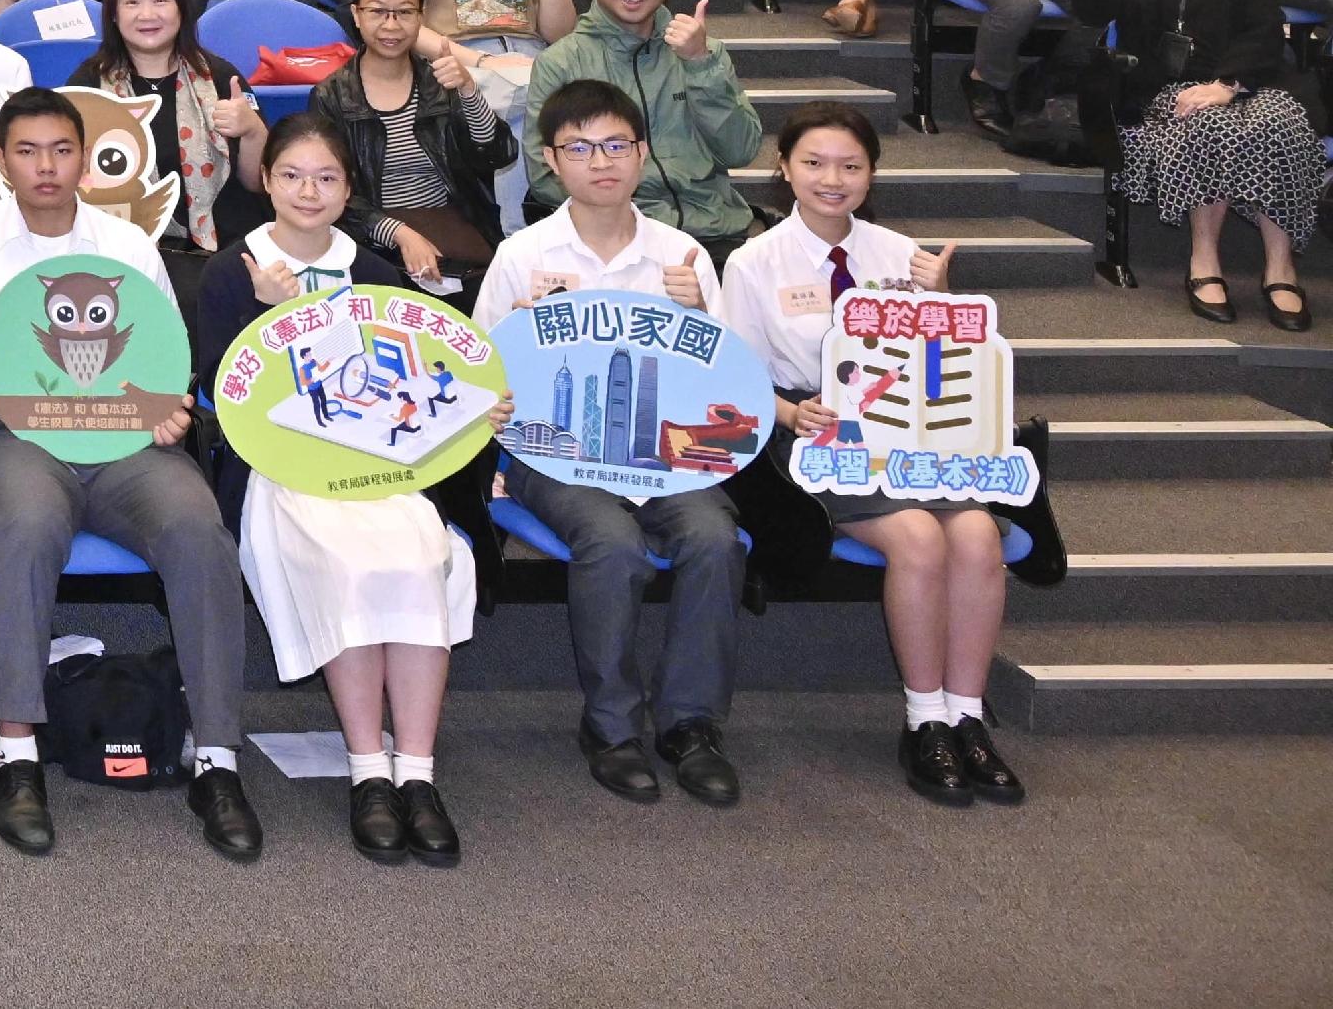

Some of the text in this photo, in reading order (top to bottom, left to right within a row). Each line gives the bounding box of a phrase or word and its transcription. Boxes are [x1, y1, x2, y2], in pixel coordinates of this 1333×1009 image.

[533, 302, 722, 365] 關心家國
[844, 298, 987, 343] 樂於學習
[222, 297, 490, 401] 學好 《憲法》 和 《基本法》
[327, 469, 415, 492] 教育局課程發展處
[573, 467, 665, 489] 教育局課程發展處
[800, 446, 1029, 495] 學習 《基本法》
[105, 744, 121, 753] JUST
[122, 744, 133, 753] DO
